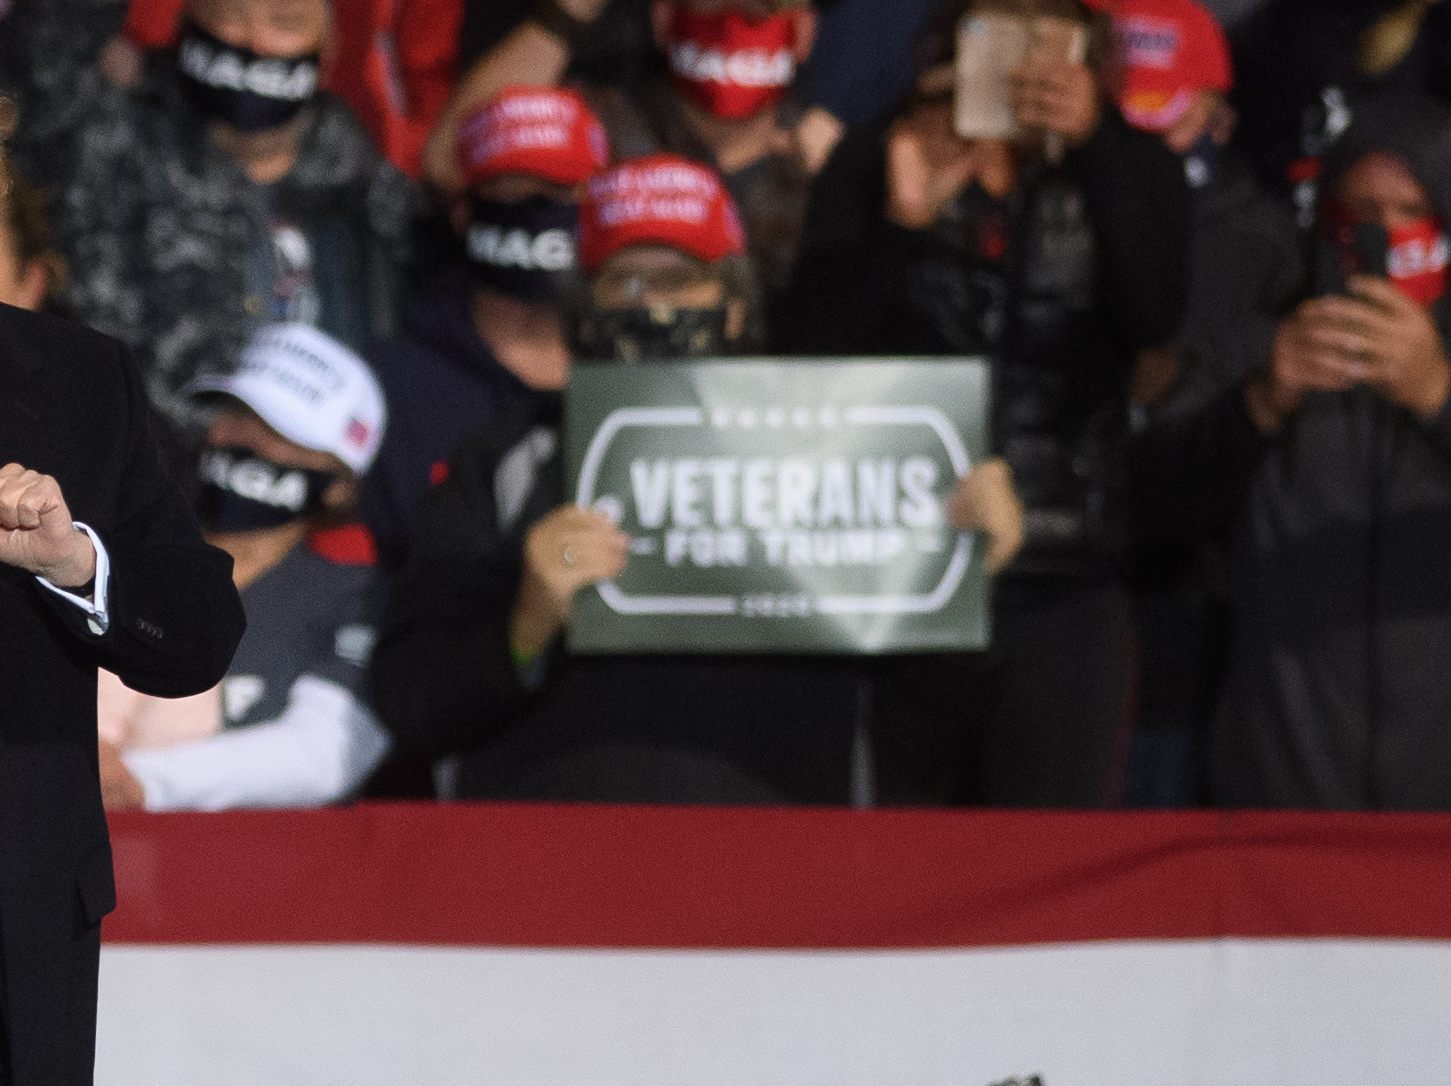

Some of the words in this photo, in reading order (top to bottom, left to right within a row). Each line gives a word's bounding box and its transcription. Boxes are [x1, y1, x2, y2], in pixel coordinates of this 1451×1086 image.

[468, 226, 577, 270] MAG
[630, 457, 937, 530] VETERANS
[664, 530, 749, 567] FOR
[762, 530, 906, 567] TRUMP
